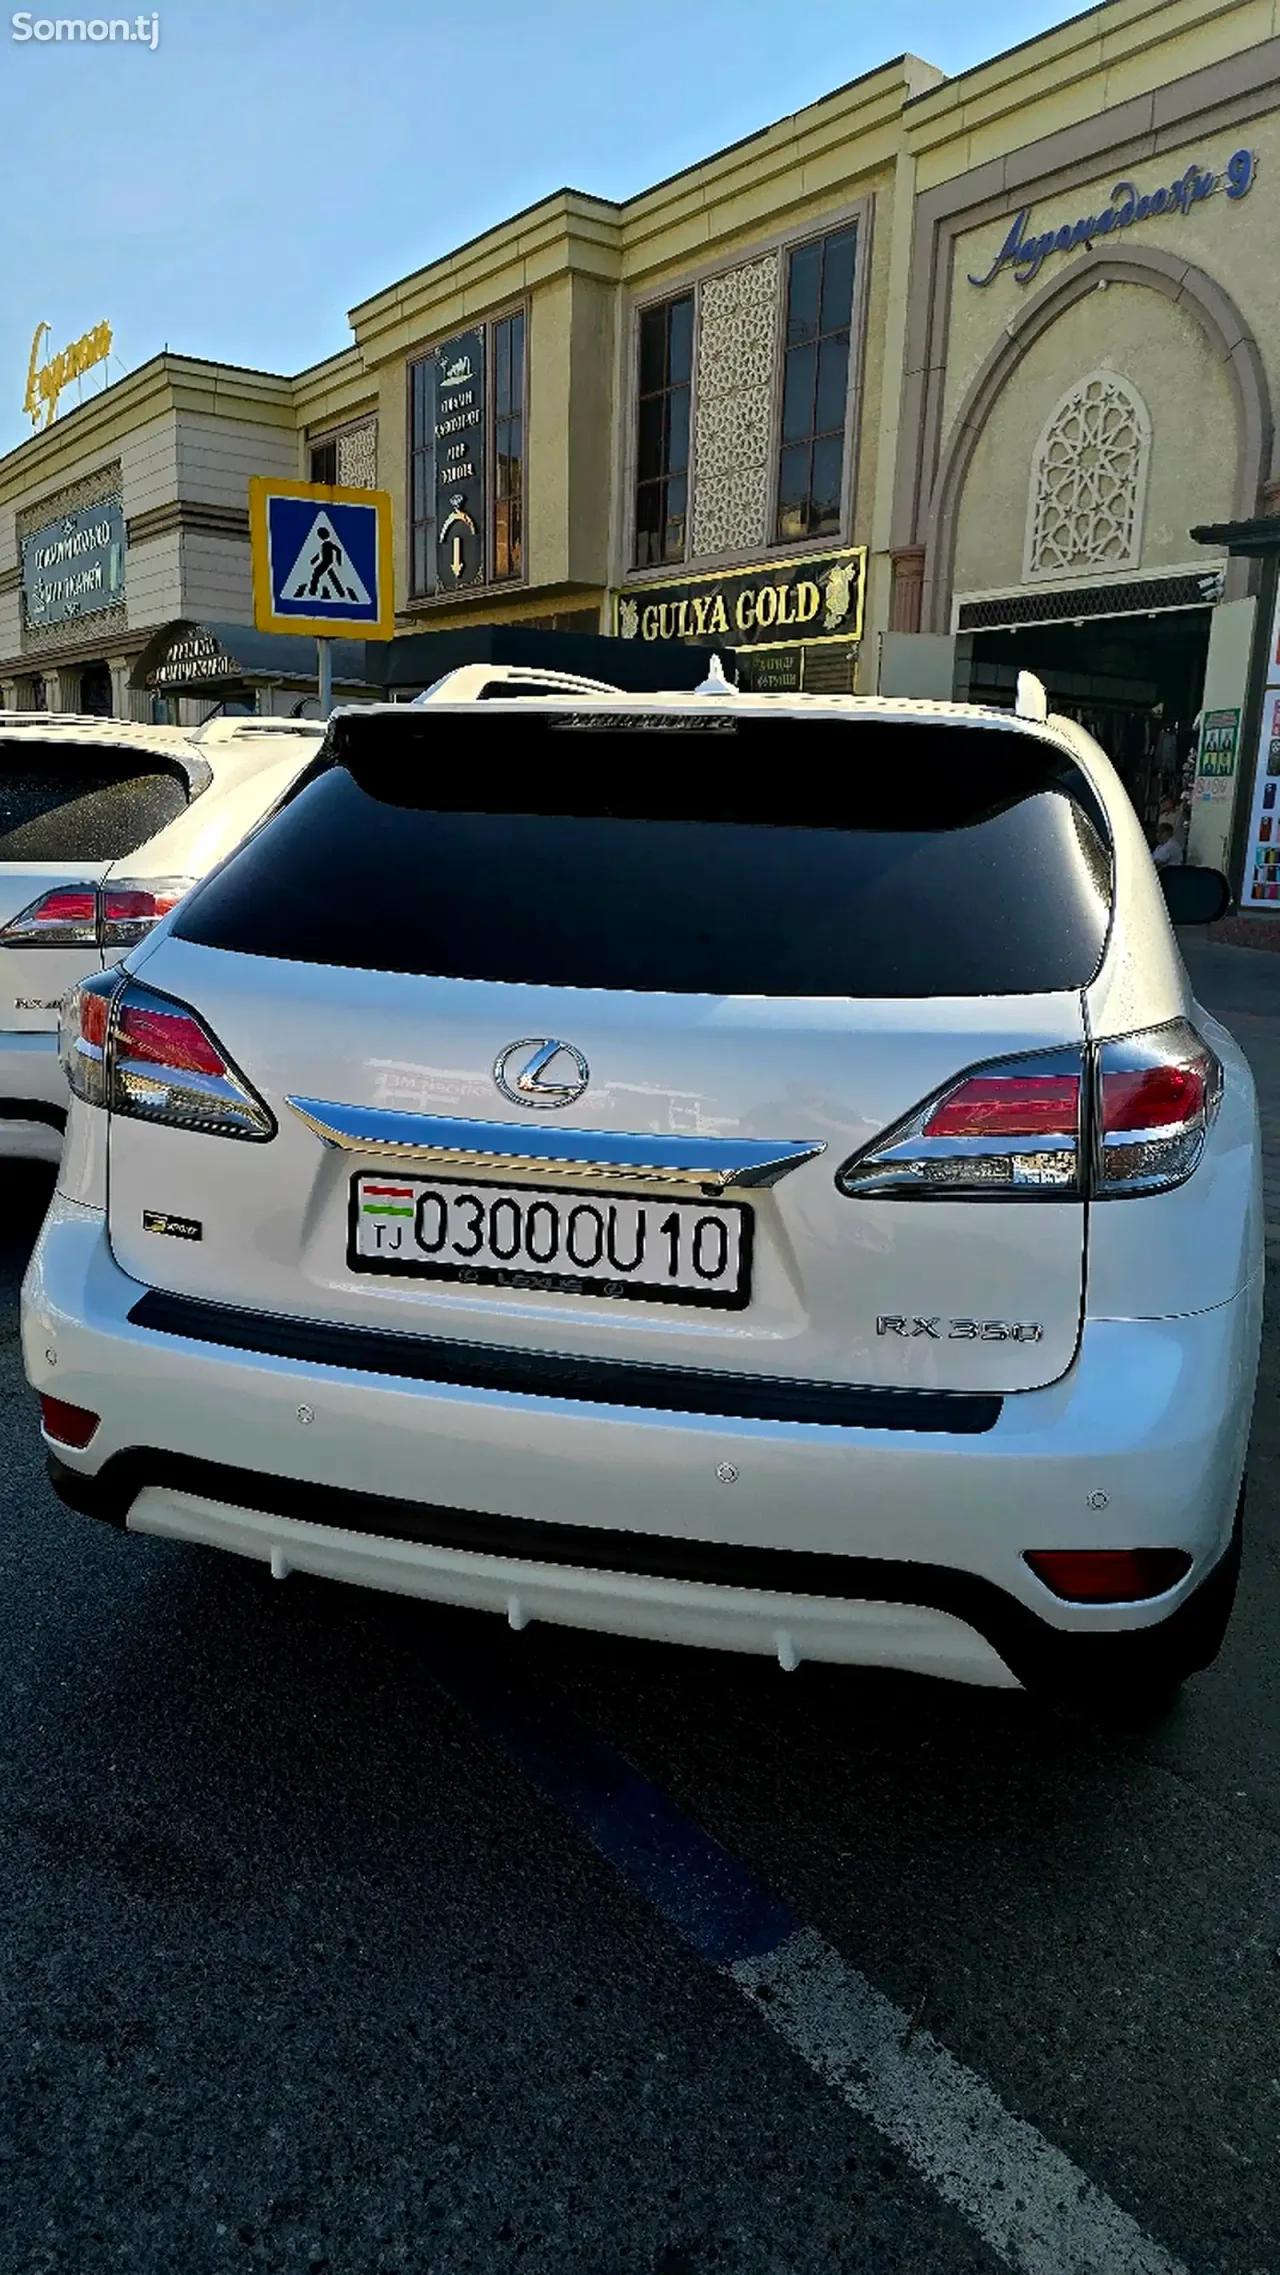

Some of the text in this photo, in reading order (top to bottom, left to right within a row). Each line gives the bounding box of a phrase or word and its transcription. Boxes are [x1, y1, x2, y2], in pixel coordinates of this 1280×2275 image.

[1225, 149, 1253, 199] 9
[641, 581, 821, 641] GULYA GOLD
[373, 1223, 402, 1250] TJ
[498, 1272, 583, 1293] LEXUS
[876, 1314, 1044, 1343] RX 350
